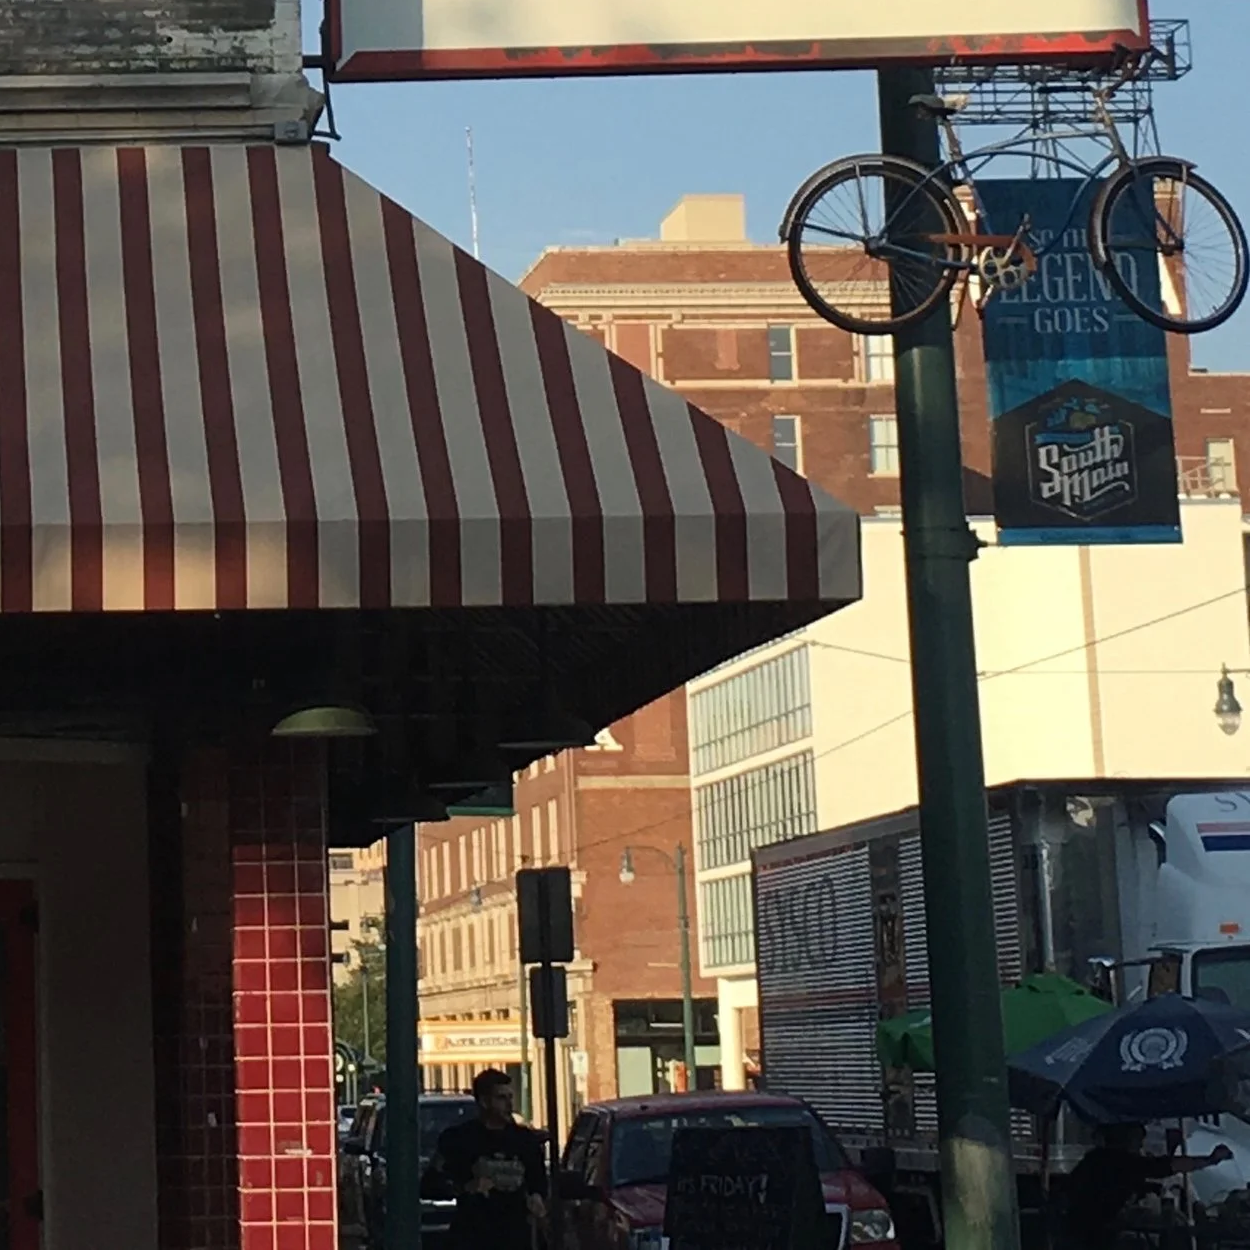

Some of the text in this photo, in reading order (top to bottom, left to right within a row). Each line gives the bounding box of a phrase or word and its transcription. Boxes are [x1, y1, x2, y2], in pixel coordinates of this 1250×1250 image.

[1033, 306, 1110, 333] GOES
[1037, 424, 1125, 499] South
[1061, 459, 1129, 507] Main
